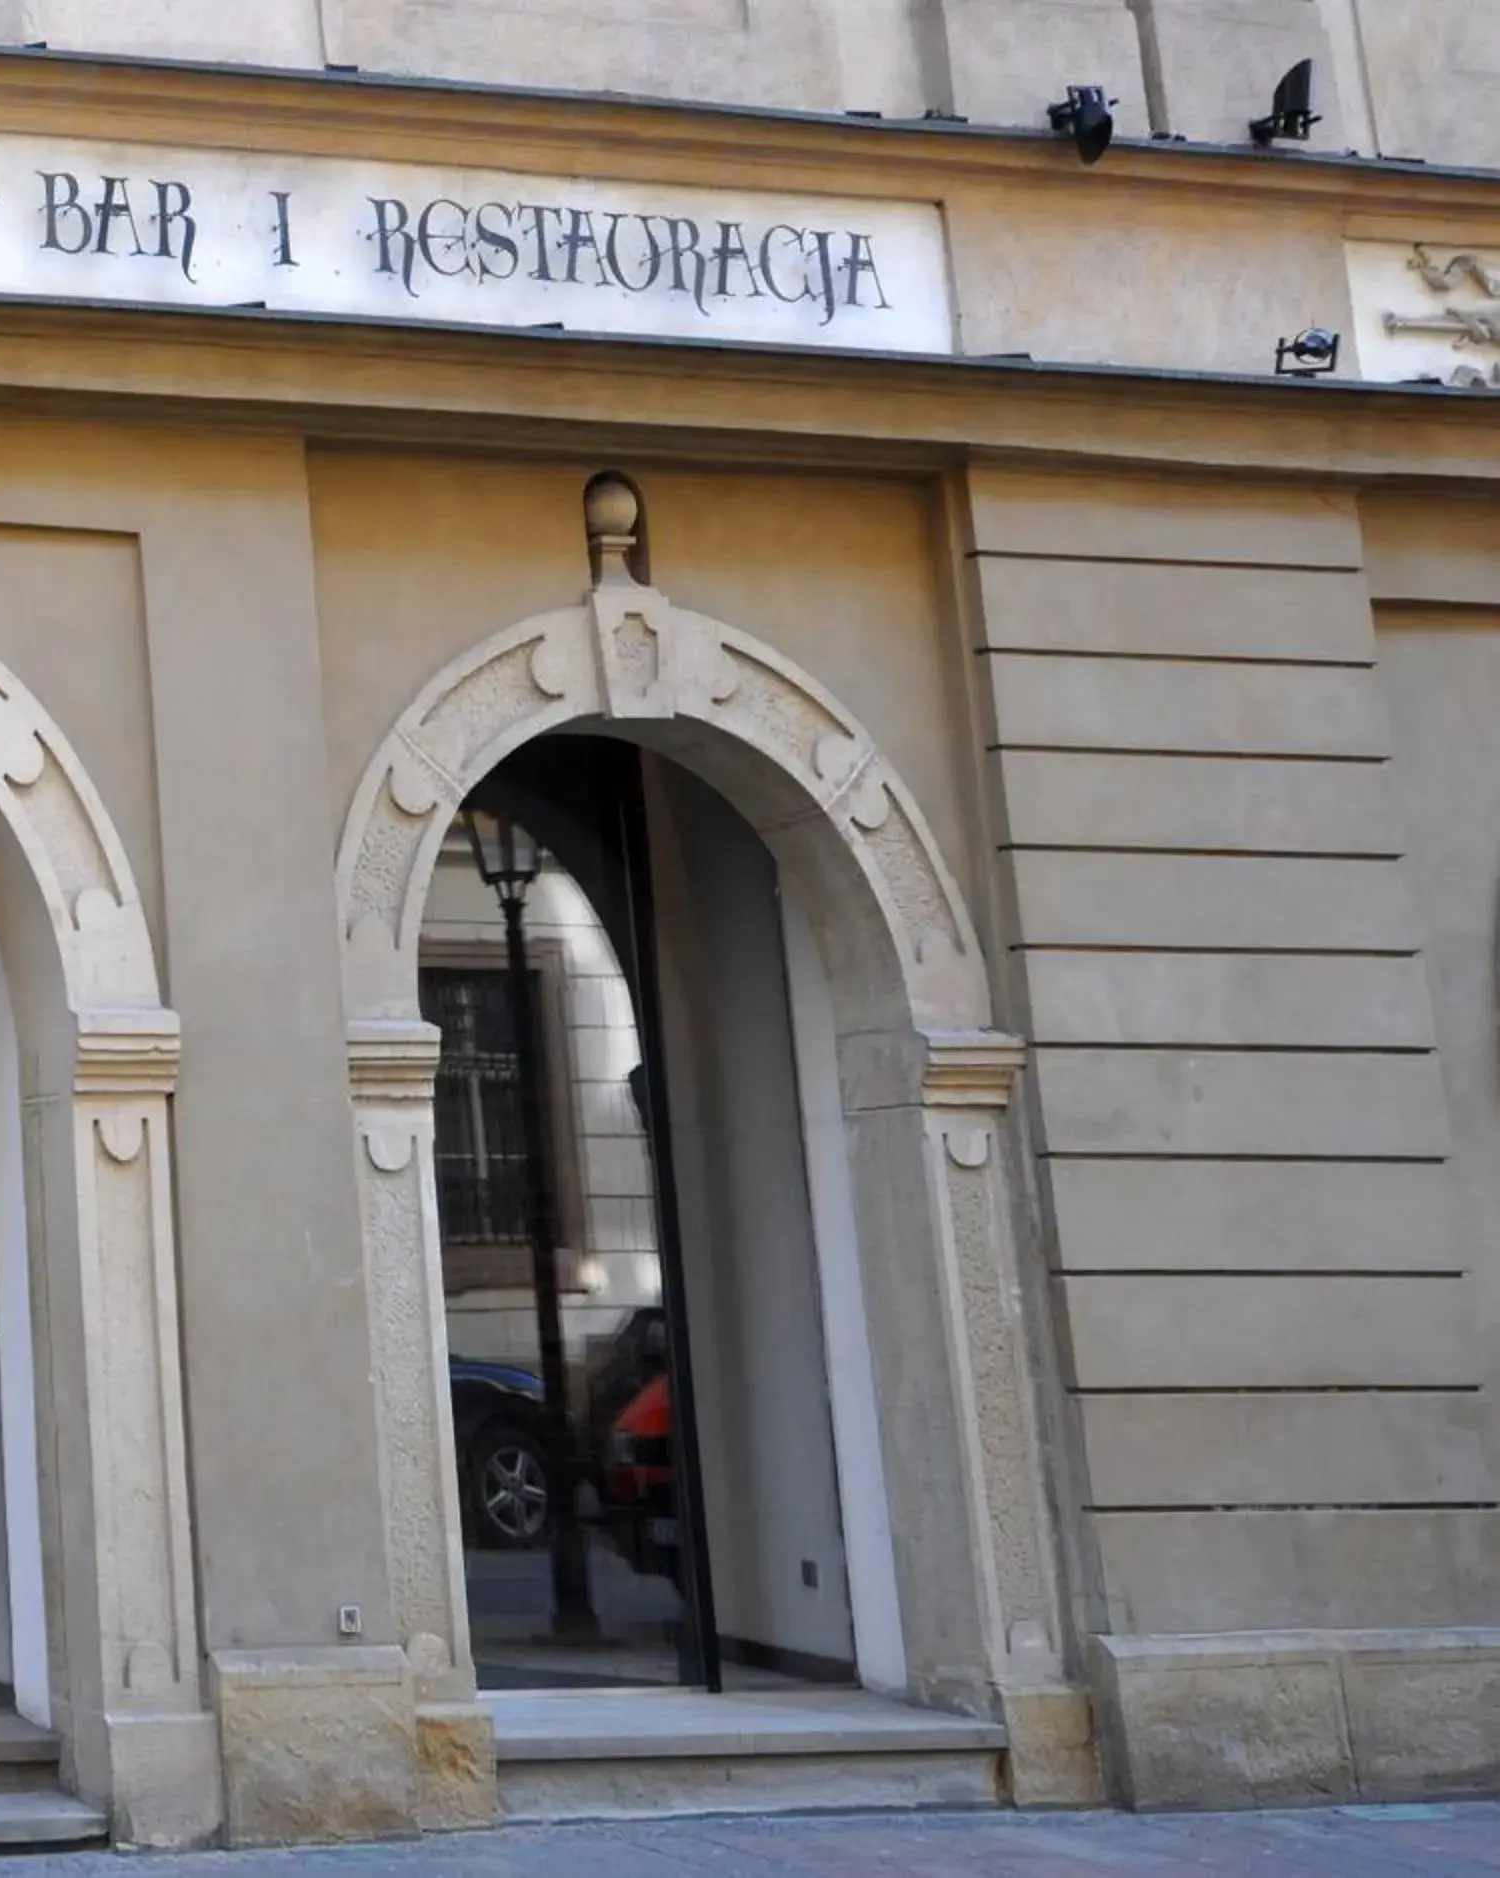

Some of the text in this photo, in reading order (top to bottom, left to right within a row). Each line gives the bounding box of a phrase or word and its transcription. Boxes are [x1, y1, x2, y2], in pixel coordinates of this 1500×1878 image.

[35, 170, 197, 284] BAR
[268, 191, 300, 267] I
[366, 197, 893, 326] RESTAURACJA
